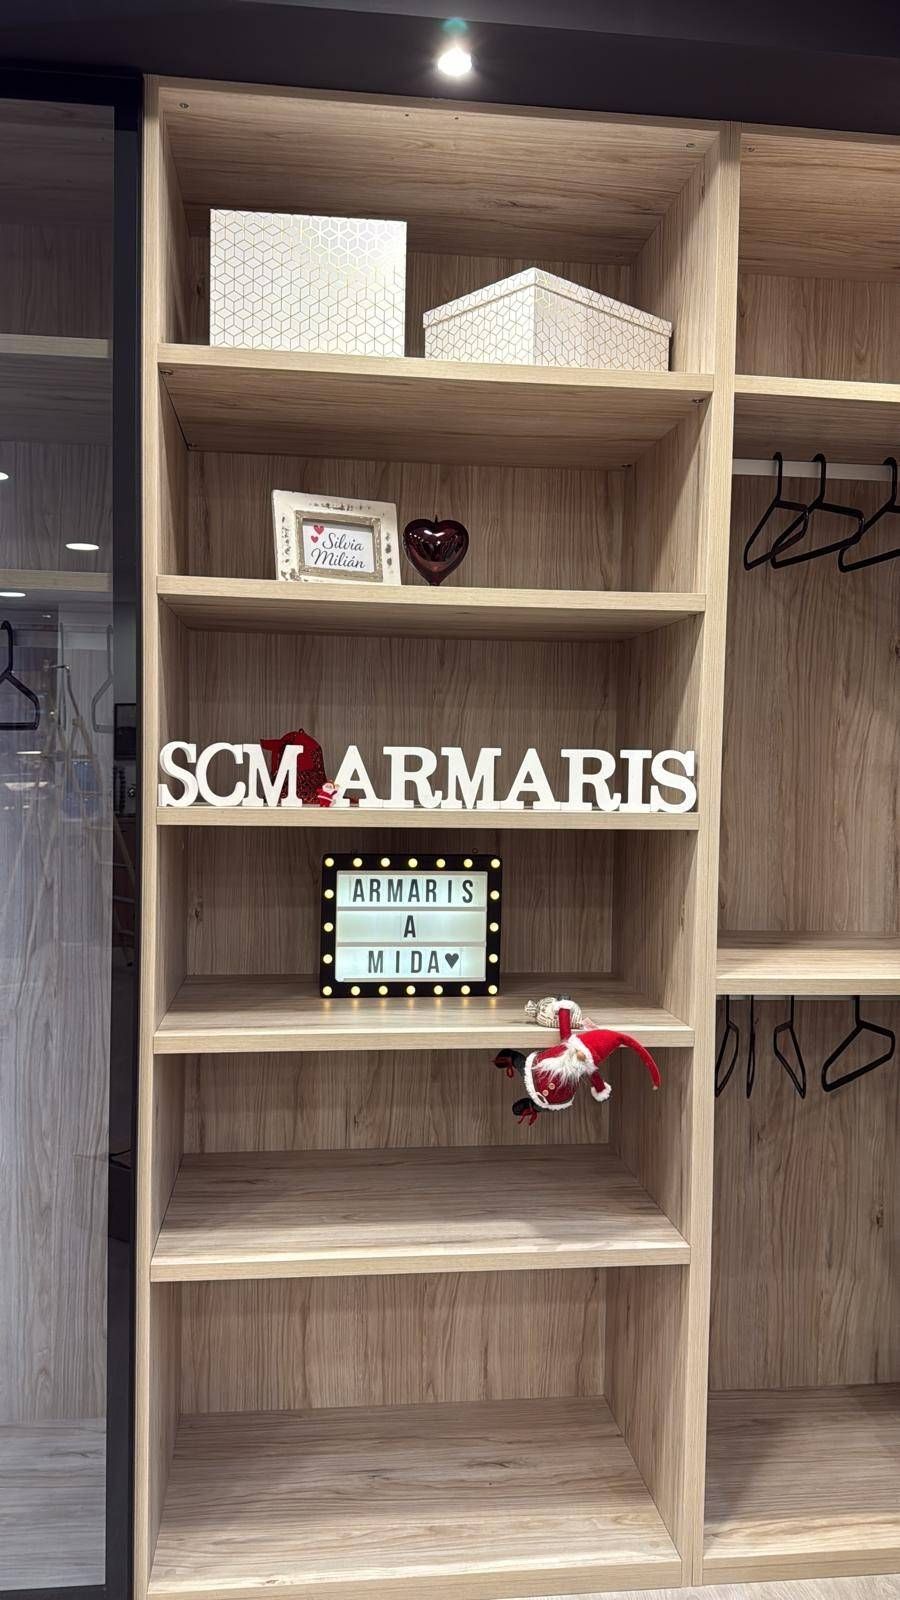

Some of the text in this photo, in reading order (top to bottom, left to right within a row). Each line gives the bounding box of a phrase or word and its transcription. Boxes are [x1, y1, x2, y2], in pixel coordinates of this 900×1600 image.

[322, 532, 365, 552] Silvia
[310, 547, 366, 569] Milián
[158, 741, 698, 813] SCM ARMARIS
[352, 878, 474, 904] ARMARIS
[403, 914, 417, 938] A
[367, 950, 440, 974] MIDA
